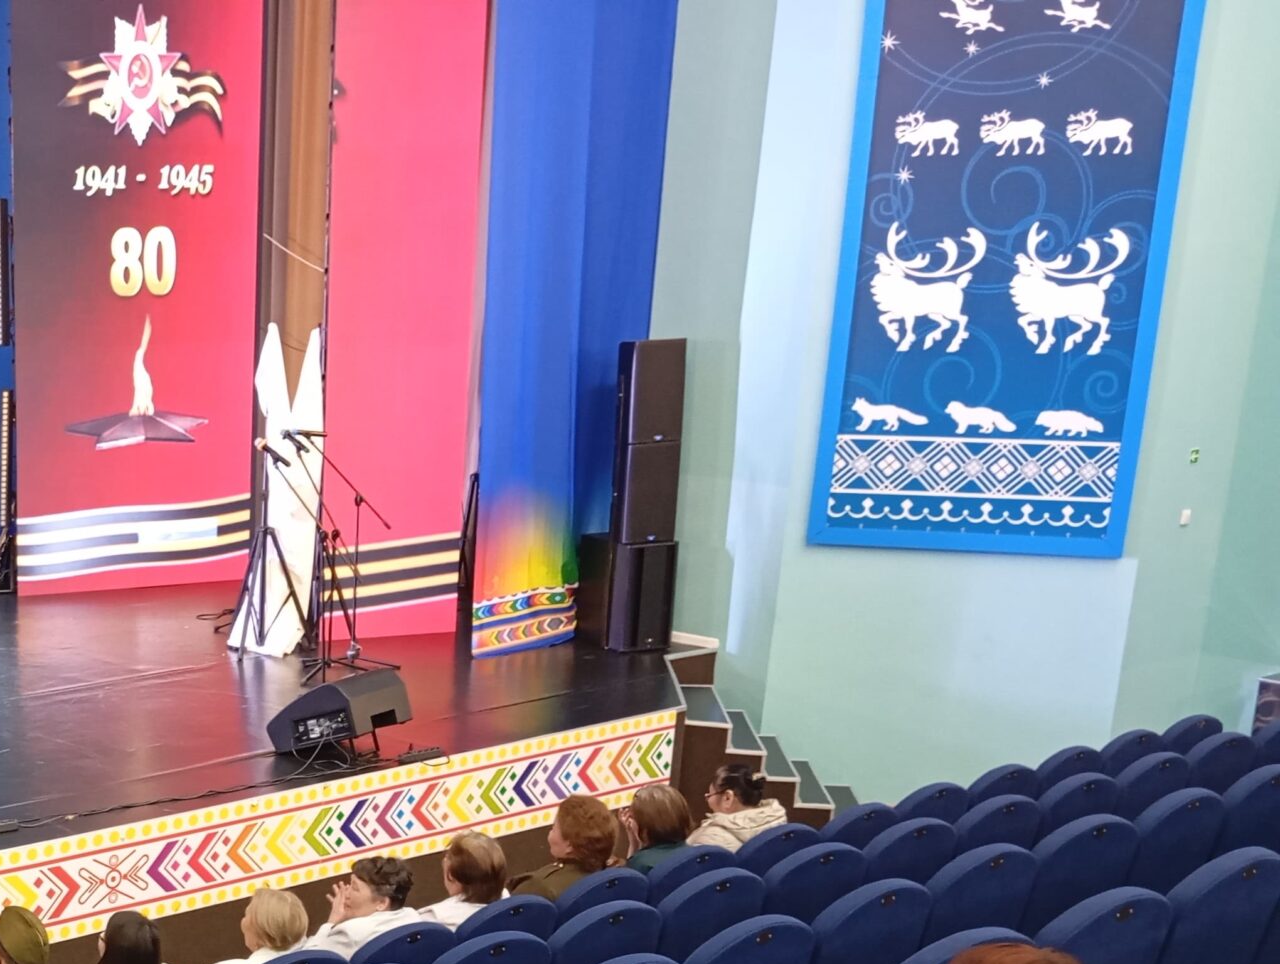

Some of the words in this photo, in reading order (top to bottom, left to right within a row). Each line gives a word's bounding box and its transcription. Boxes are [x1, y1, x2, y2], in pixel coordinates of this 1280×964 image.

[72, 165, 127, 196] 1941
[158, 164, 214, 195] 1945
[110, 225, 177, 297] 80
